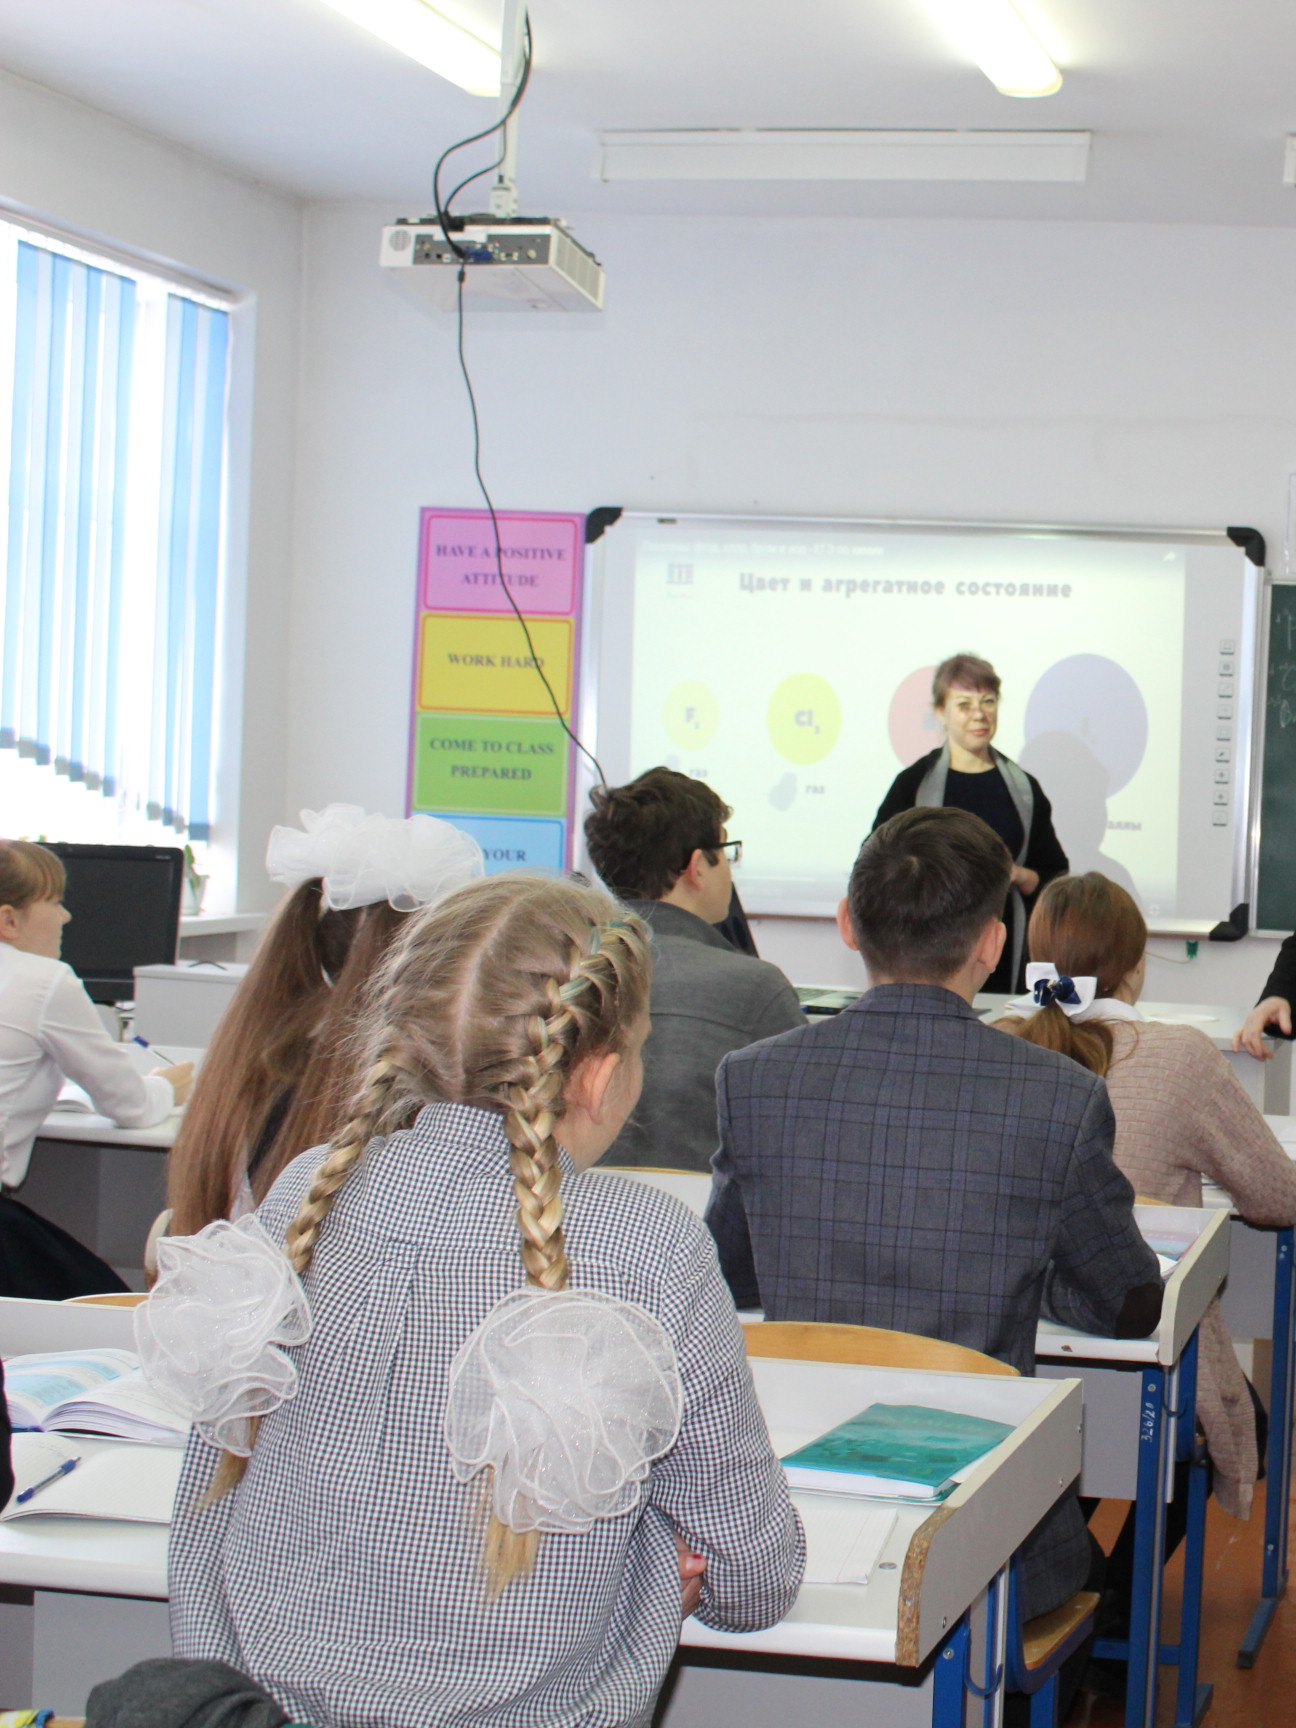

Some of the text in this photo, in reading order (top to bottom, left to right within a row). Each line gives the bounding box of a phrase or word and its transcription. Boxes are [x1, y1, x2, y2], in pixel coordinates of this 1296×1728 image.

[436, 544, 566, 561] HAVE A POSITIVE
[739, 572, 1073, 599] Цвет и агрегатное состояние
[447, 653, 545, 670] WORK HARD
[429, 738, 555, 755] COME TO CLASS
[450, 764, 532, 781] PREPARED
[483, 847, 527, 862] YOUR
